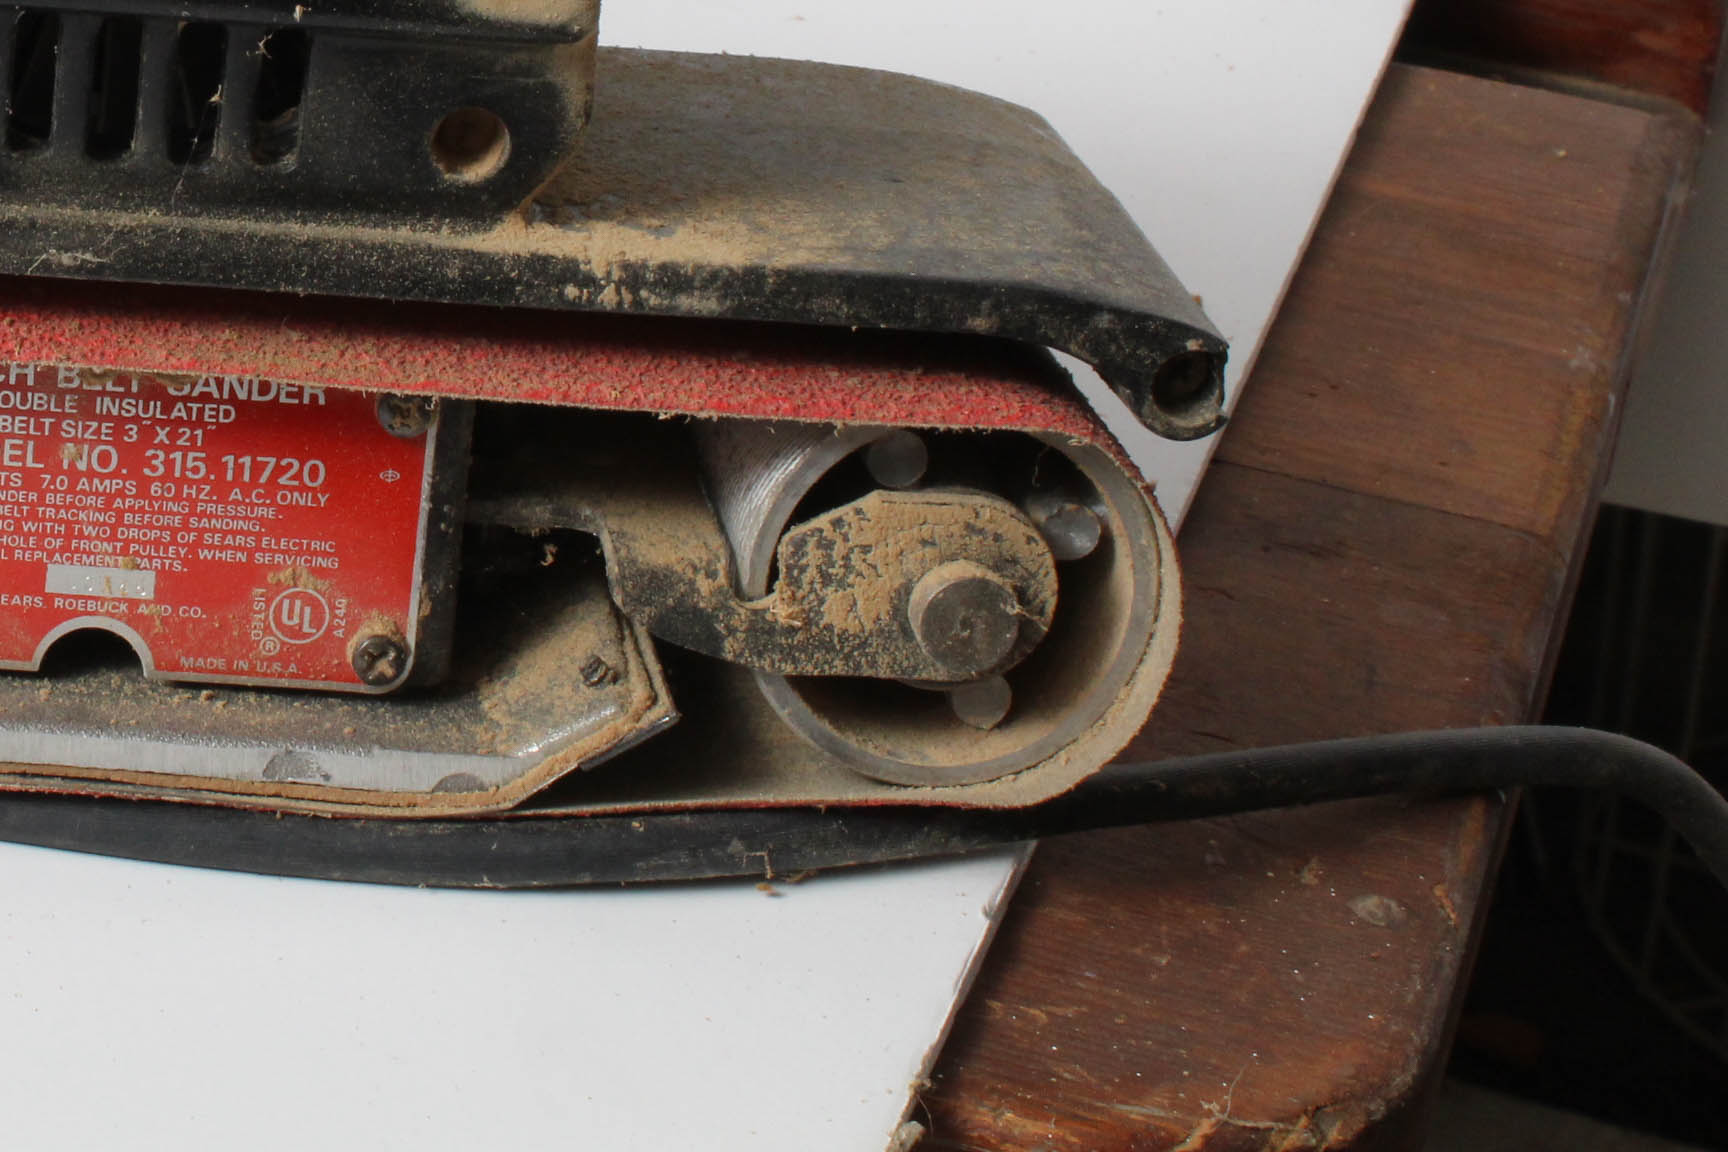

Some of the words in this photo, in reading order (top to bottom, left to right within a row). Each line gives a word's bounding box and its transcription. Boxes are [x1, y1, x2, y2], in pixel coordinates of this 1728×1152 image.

[57, 365, 139, 393] BL
[95, 396, 236, 424] INSULATED
[60, 419, 114, 441] SIZE
[153, 426, 171, 445] X
[62, 443, 128, 475] NO.
[142, 448, 327, 488] 315.11720
[40, 474, 69, 491] 7.0
[76, 477, 137, 496] AMPS
[150, 482, 176, 498] 60
[183, 486, 218, 501] HZ.
[228, 488, 272, 505] A.C.
[276, 490, 331, 508] ONLY
[37, 506, 116, 524] TRACKING
[123, 512, 183, 528] BEFORE
[188, 516, 266, 533] SANDING.
[46, 493, 105, 508] BEFORE
[113, 497, 190, 514] APPLYING
[196, 502, 284, 520] PRESSURE.
[22, 520, 65, 535] WITH
[72, 523, 111, 538] TWO
[117, 527, 171, 543] DROPS
[177, 530, 198, 544] OF
[203, 532, 256, 548] SEARS
[261, 536, 336, 554] ELECTRIC
[13, 550, 122, 569] REPLACEMENT
[43, 537, 64, 550] OF
[71, 539, 124, 554] FRONT
[129, 543, 193, 560] PULLEY.
[198, 548, 247, 563] WHEN
[253, 551, 340, 569] SERVICING
[54, 597, 129, 615] ROEBUCK
[137, 604, 172, 617] AD
[179, 605, 207, 619] CO.
[251, 588, 267, 641] LISTED
[282, 598, 318, 634] UL
[180, 655, 227, 670] MADE
[233, 659, 249, 672] IN
